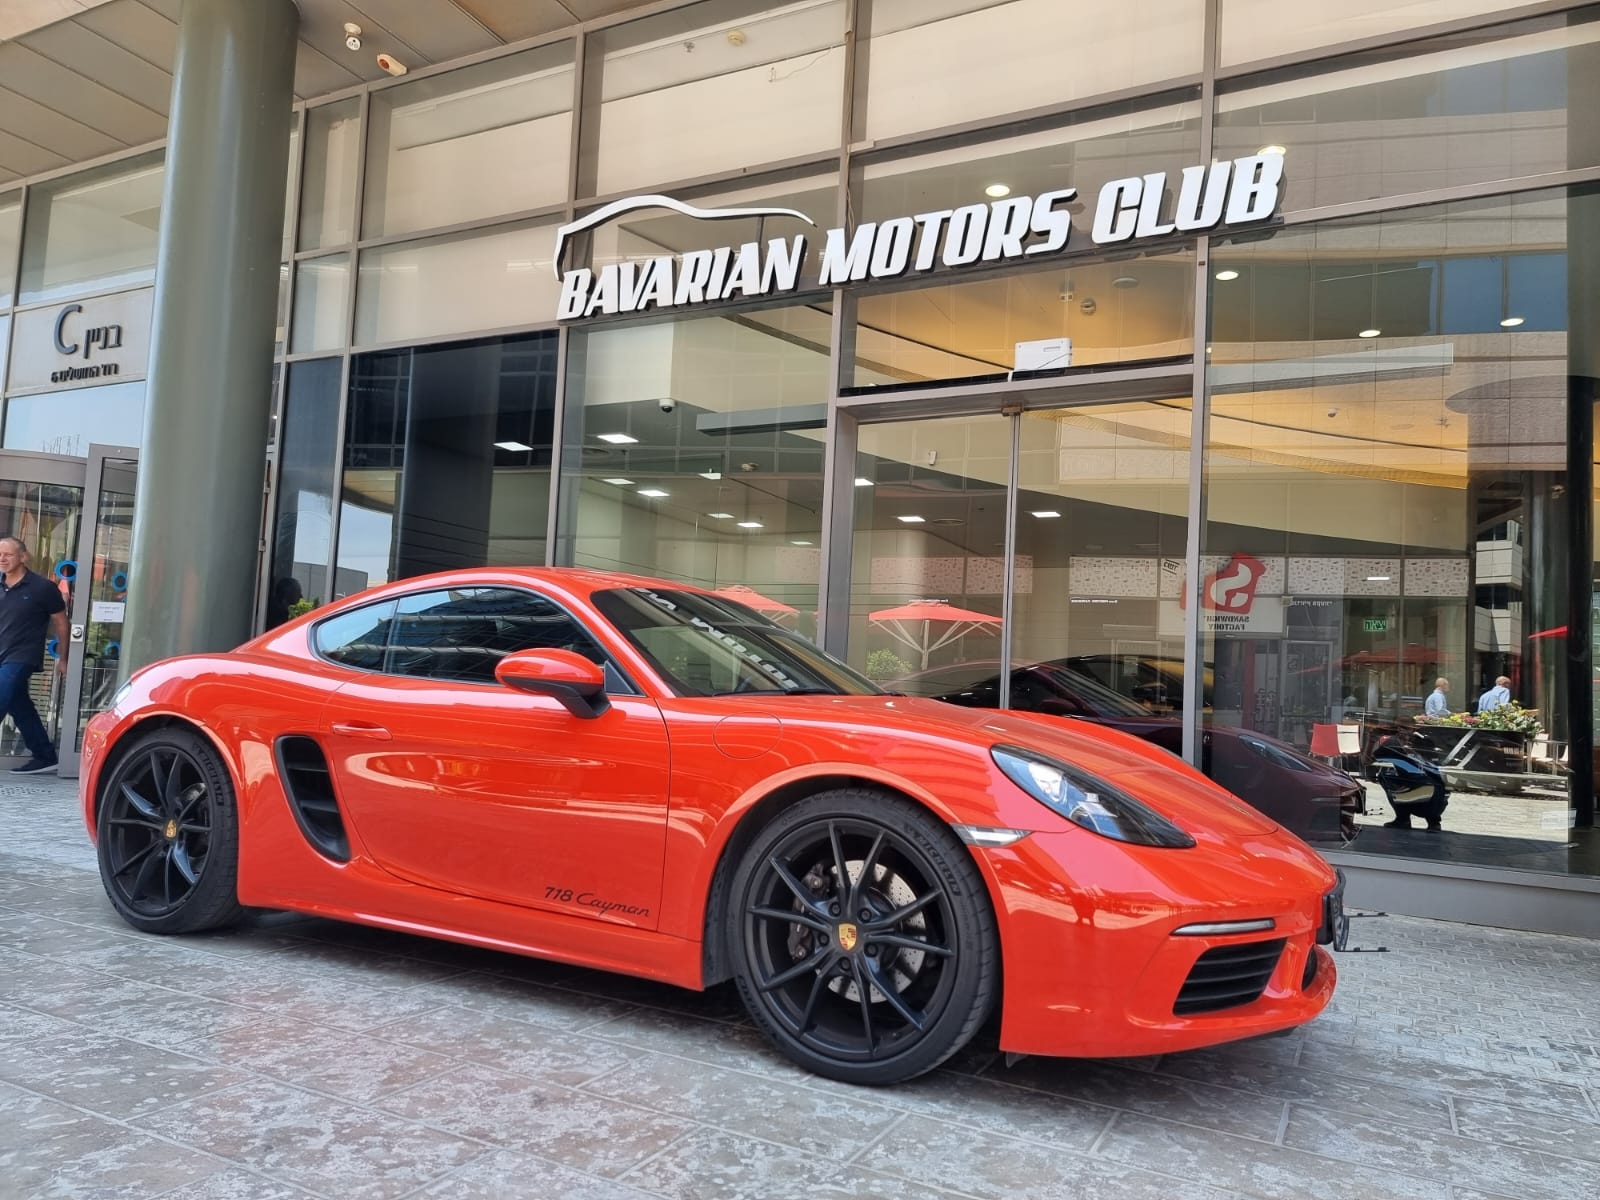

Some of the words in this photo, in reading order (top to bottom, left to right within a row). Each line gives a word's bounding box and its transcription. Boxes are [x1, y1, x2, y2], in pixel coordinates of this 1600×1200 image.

[557, 234, 807, 321] BAVARIAN
[818, 187, 1078, 286] MOTORS
[1091, 154, 1285, 245] CLUB
[54, 303, 83, 355] C
[83, 324, 122, 360] בניין
[51, 371, 59, 383] 6
[917, 834, 962, 896] MICHELIN
[544, 886, 574, 903] 718
[576, 892, 650, 917] Cayman
